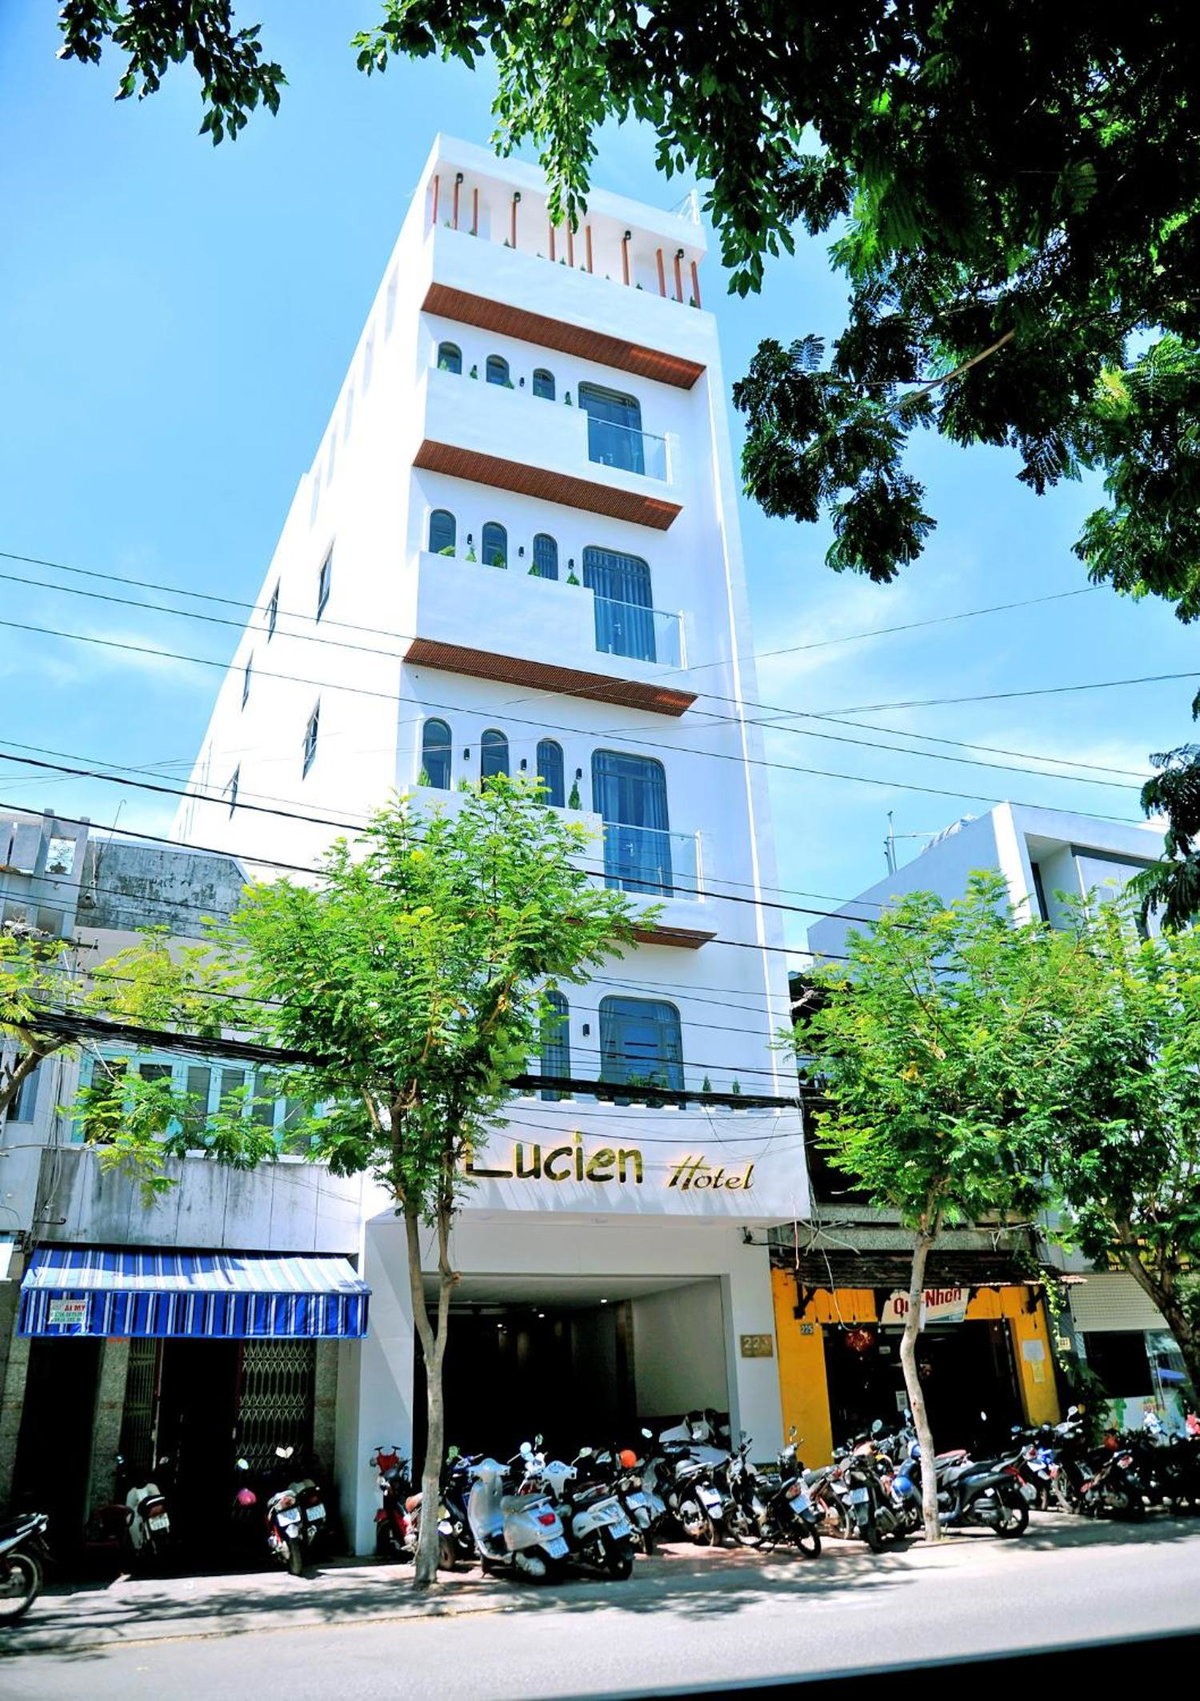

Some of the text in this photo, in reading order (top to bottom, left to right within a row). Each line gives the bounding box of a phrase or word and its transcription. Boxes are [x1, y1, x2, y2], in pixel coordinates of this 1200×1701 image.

[465, 1124, 755, 1190] Lucien Hotel
[743, 1336, 769, 1349] 223
